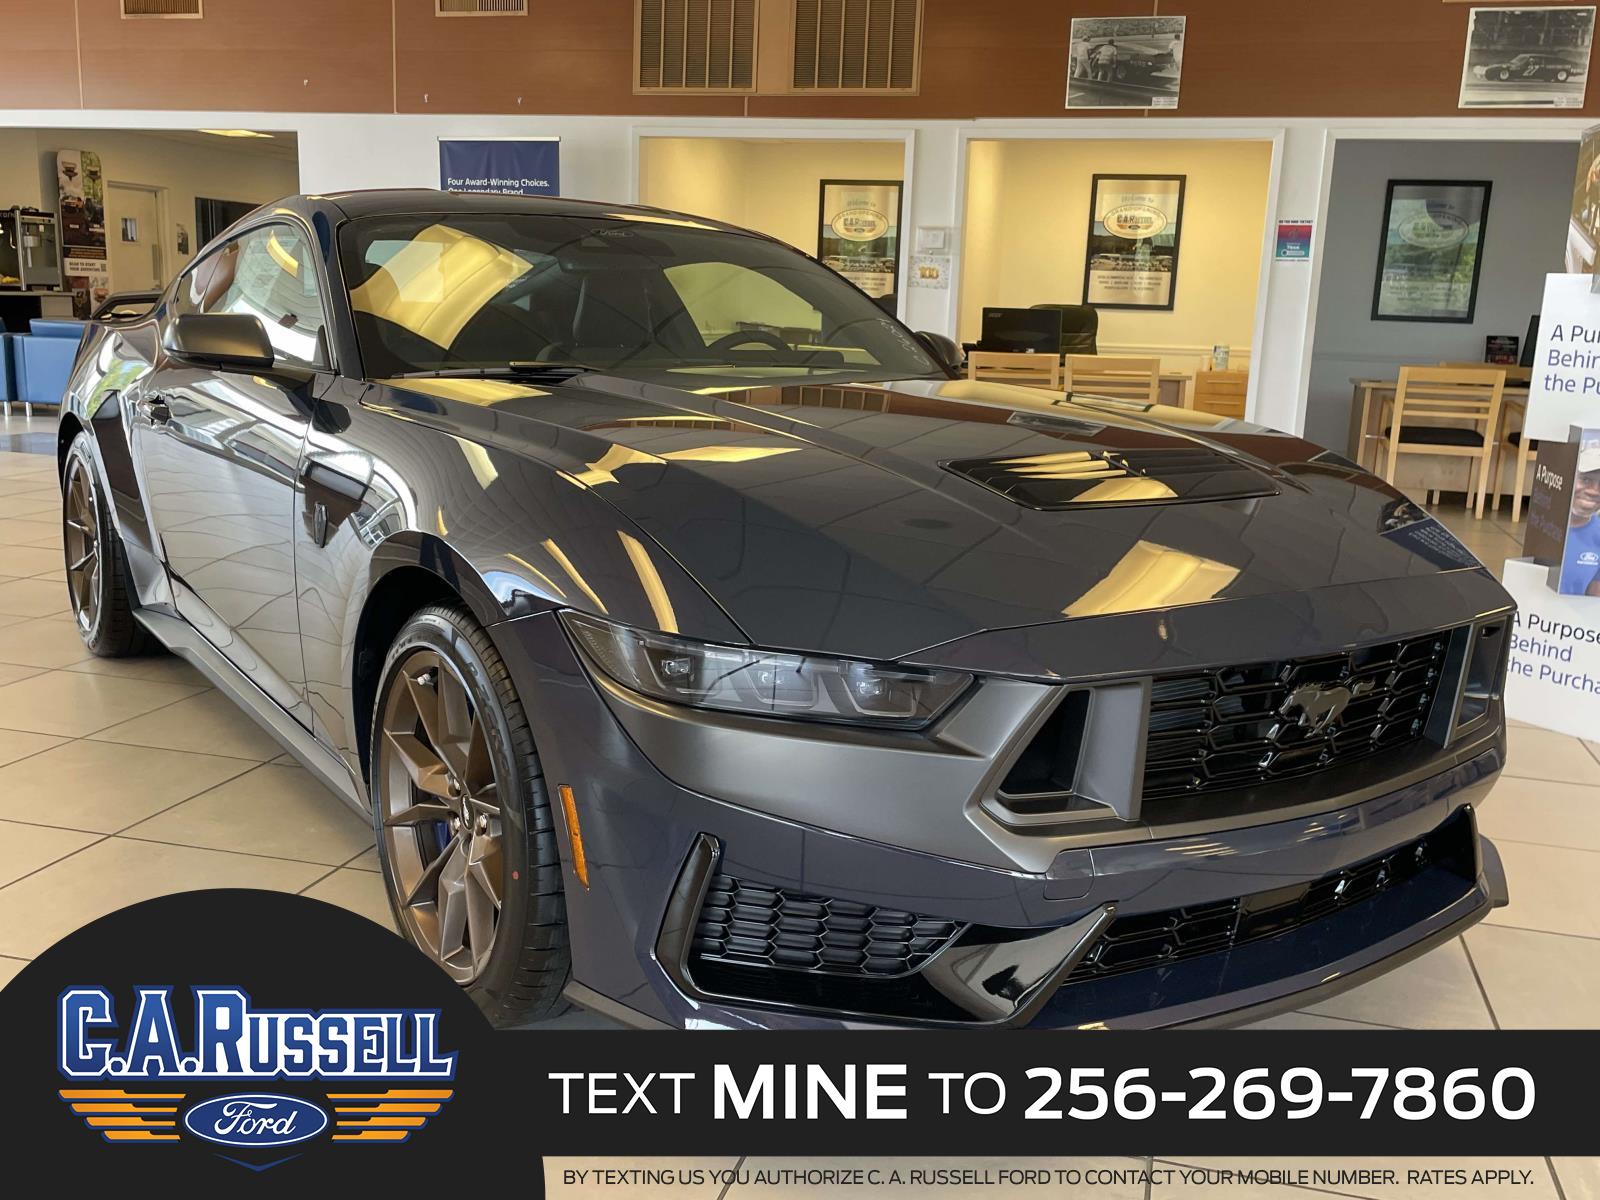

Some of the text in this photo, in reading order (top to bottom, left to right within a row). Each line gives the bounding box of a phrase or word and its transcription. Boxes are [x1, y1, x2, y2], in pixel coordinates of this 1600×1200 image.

[447, 177, 550, 188] Four Award-Winning Choices.
[1551, 324, 1564, 341] A
[1544, 374, 1577, 393] the
[1541, 465, 1563, 491] Purpose
